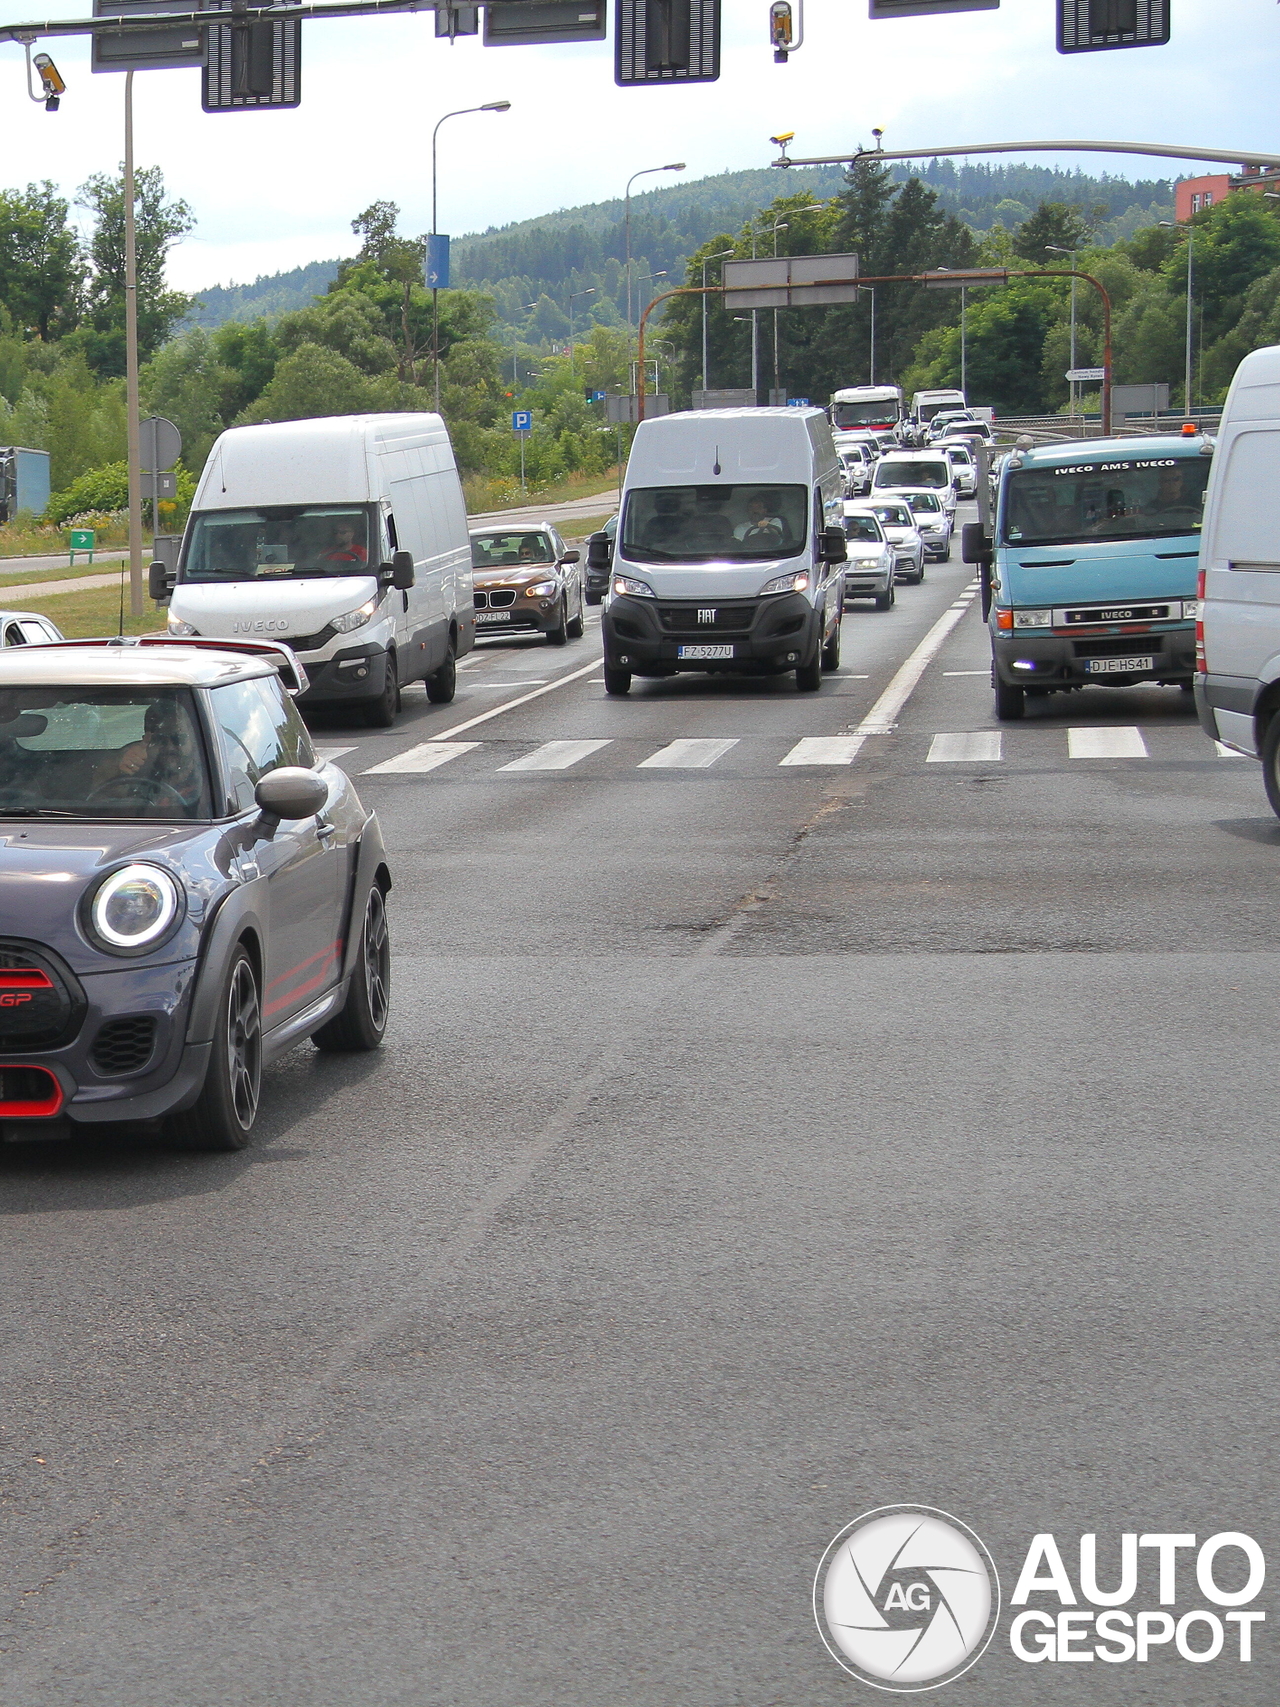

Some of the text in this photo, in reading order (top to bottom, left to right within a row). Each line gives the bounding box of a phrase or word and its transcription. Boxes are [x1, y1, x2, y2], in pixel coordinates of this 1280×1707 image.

[516, 413, 528, 428] P
[1054, 459, 1175, 475] IVECO AMS IVECO
[697, 609, 717, 623] FIAT
[1101, 611, 1132, 619] IVECO
[233, 619, 289, 633] IVECO
[684, 646, 731, 656] FZ 5277U
[1092, 658, 1149, 672] DJE HS41
